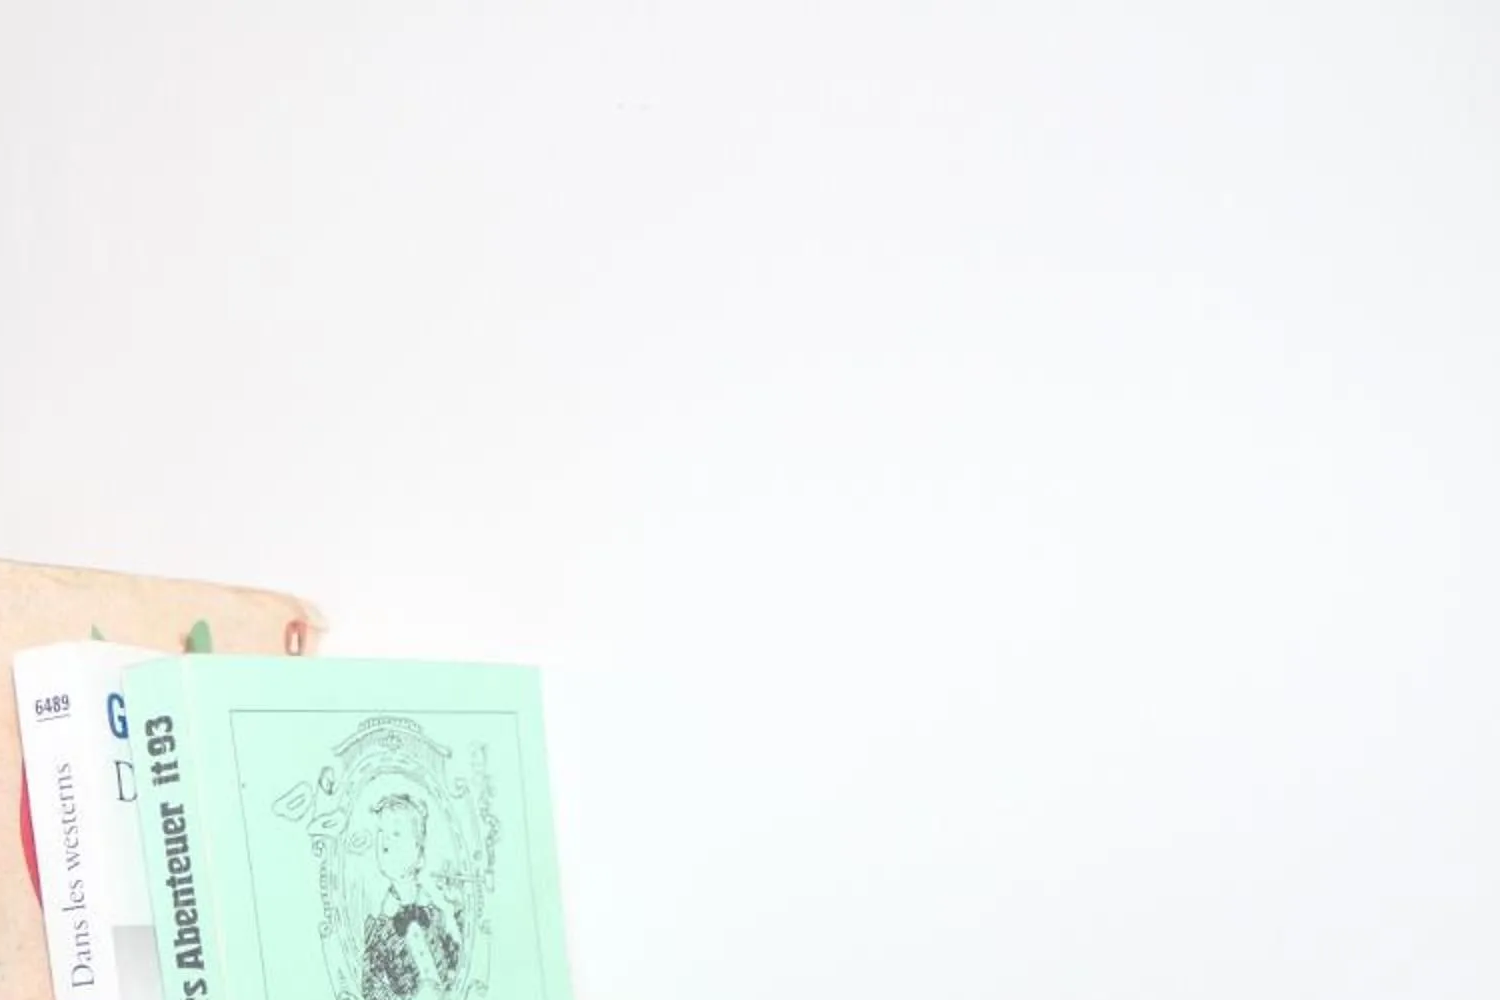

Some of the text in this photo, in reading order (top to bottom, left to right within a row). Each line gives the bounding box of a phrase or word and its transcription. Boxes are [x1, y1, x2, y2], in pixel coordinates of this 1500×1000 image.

[35, 694, 70, 716] 6489
[57, 761, 80, 873] westerns
[62, 879, 86, 914] les
[160, 801, 205, 970] Abenteuer
[71, 919, 95, 989] Dans
